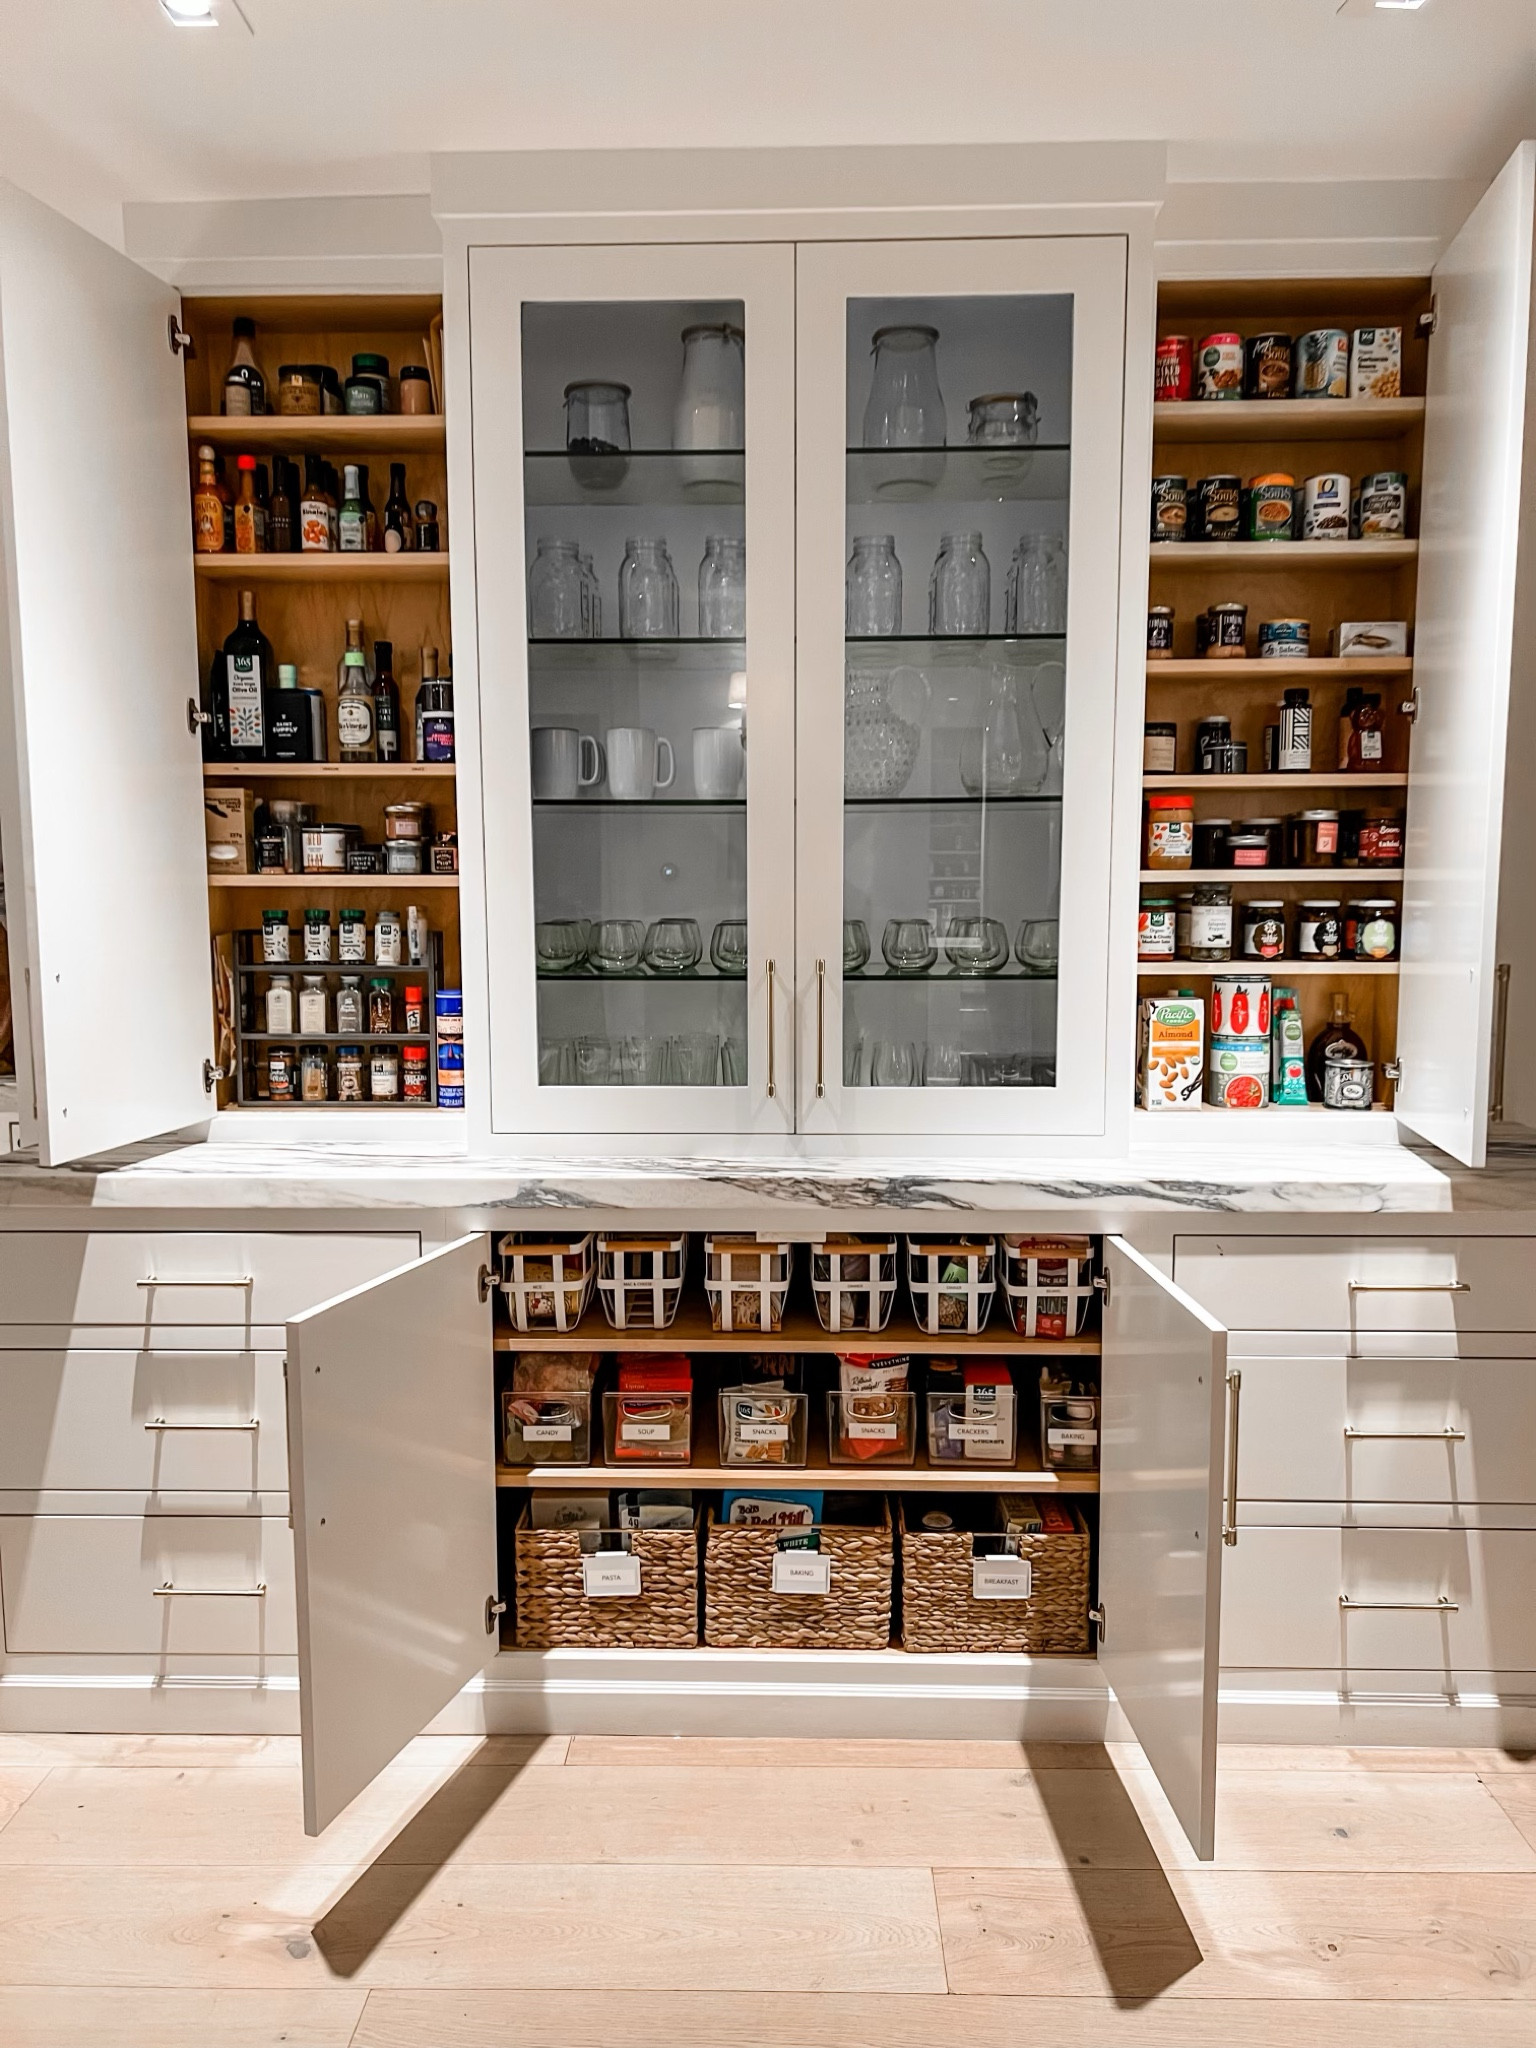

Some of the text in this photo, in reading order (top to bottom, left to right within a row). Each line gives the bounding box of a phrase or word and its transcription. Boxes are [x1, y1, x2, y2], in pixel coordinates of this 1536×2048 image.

[236, 657, 251, 667] 365
[1160, 1007, 1193, 1020] Pacific
[1158, 1030, 1193, 1038] Almond
[973, 1408, 994, 1416] Organic
[751, 1509, 805, 1525] Red Mill
[783, 1538, 809, 1547] WHITE
